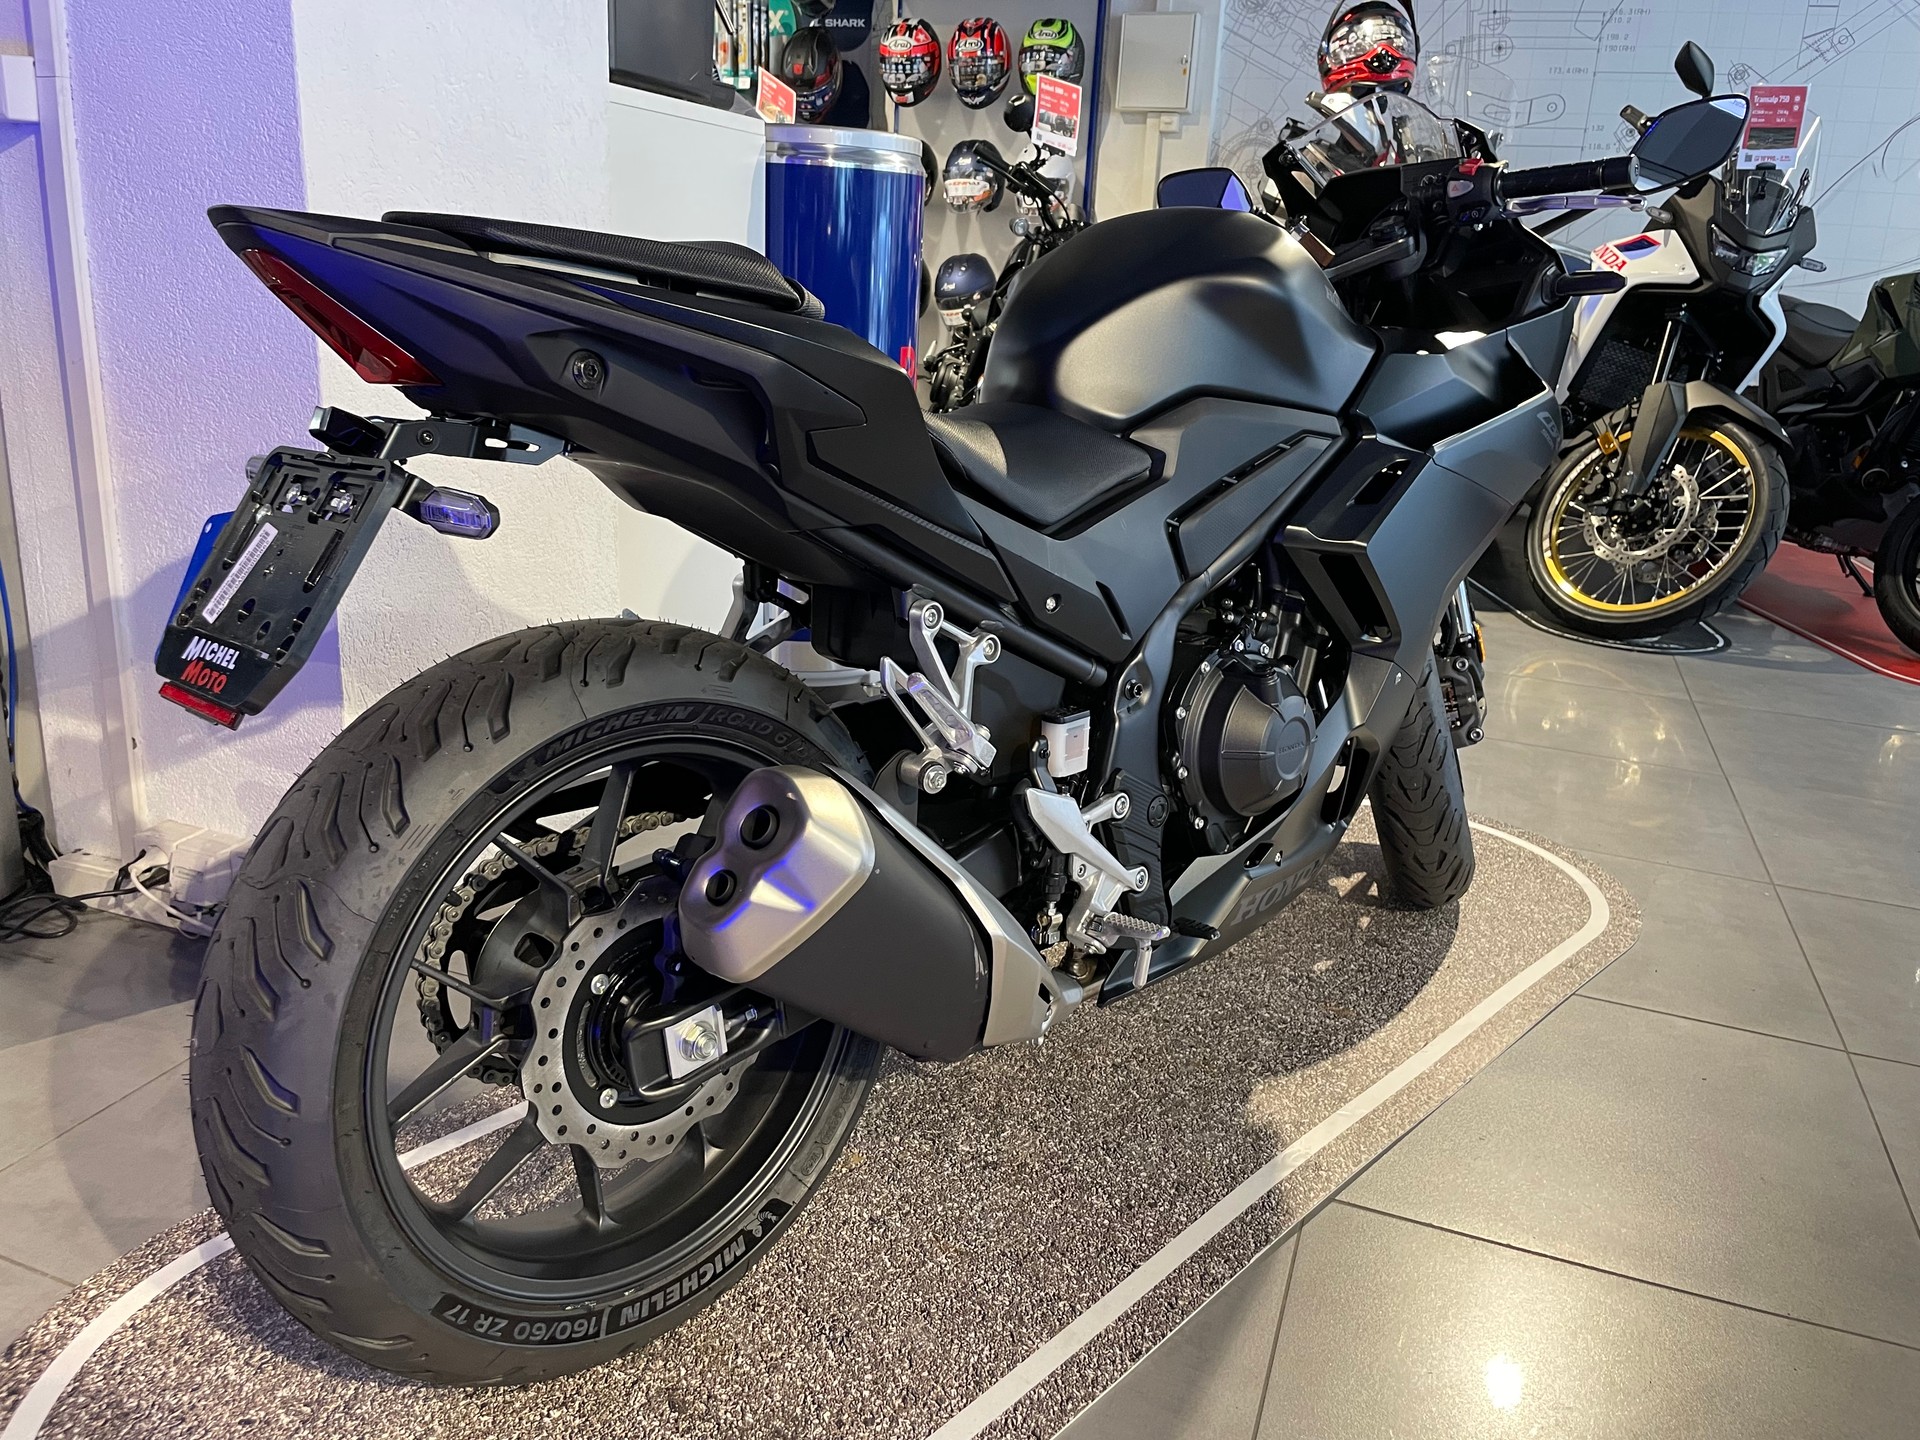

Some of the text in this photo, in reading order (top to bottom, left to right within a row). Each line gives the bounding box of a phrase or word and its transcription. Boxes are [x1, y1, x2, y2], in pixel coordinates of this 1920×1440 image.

[824, 18, 866, 28] SHARK
[1036, 30, 1056, 39] Arai
[890, 40, 911, 50] Arai
[181, 635, 240, 670] MICHEL
[180, 659, 228, 694] MOTO
[545, 705, 793, 761] MICHELIN ROAD 6
[442, 1235, 747, 1342] MICHELIN 160/60 ZR 17
